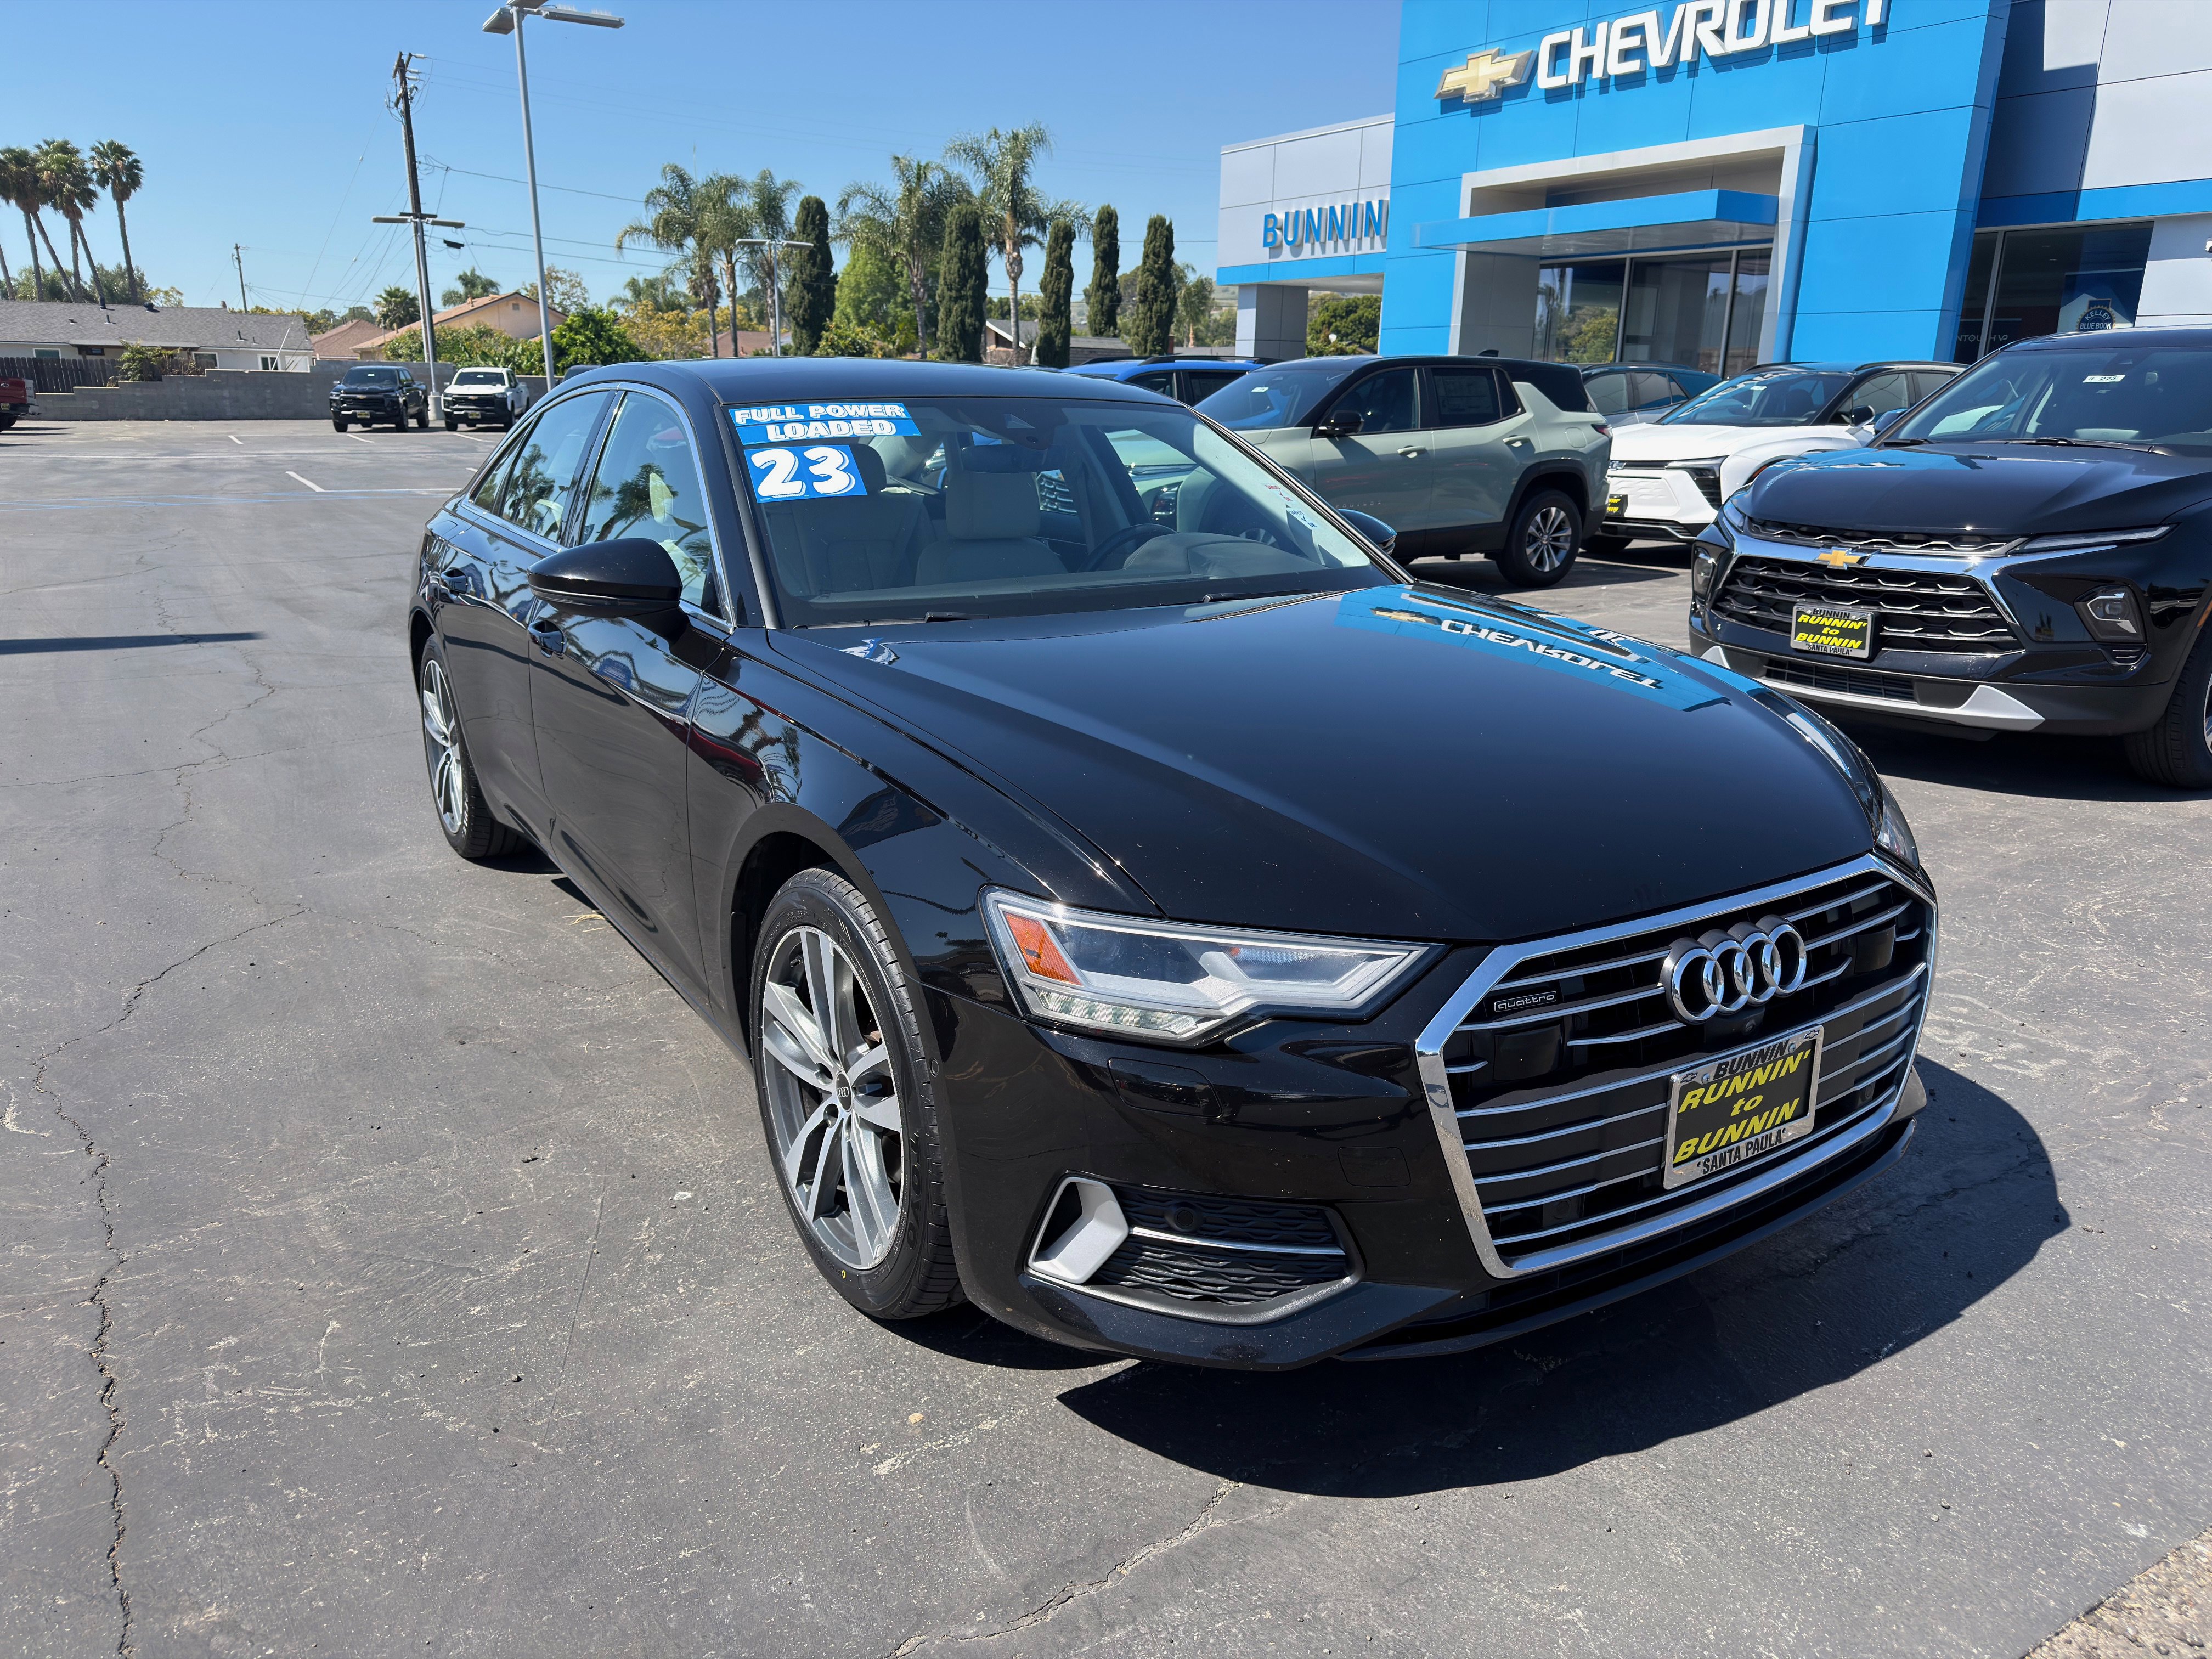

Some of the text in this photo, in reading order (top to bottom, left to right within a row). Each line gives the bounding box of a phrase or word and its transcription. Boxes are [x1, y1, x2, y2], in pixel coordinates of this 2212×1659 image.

[1263, 199, 1388, 248] BUNNIN
[2085, 310, 2111, 320] KELLEY
[735, 403, 907, 424] FULL POWER
[766, 420, 896, 441] LOADED
[751, 447, 855, 499] 23
[1797, 614, 1867, 630] RUNNIN'
[1813, 608, 1850, 619] BUNNIN
[1795, 633, 1863, 649] BUNNIN
[1822, 627, 1840, 635] to
[1808, 644, 1850, 655] SANTA PAULA
[1498, 994, 1554, 1010] quattro
[1713, 1039, 1791, 1080] BUNNIN
[1678, 1049, 1812, 1114] RUNNIN'
[1730, 1095, 1763, 1116] to
[1673, 1097, 1800, 1164] BUNNIN
[1702, 1128, 1782, 1175] SANTA PAULA
[907, 1132, 922, 1250] TOYO
